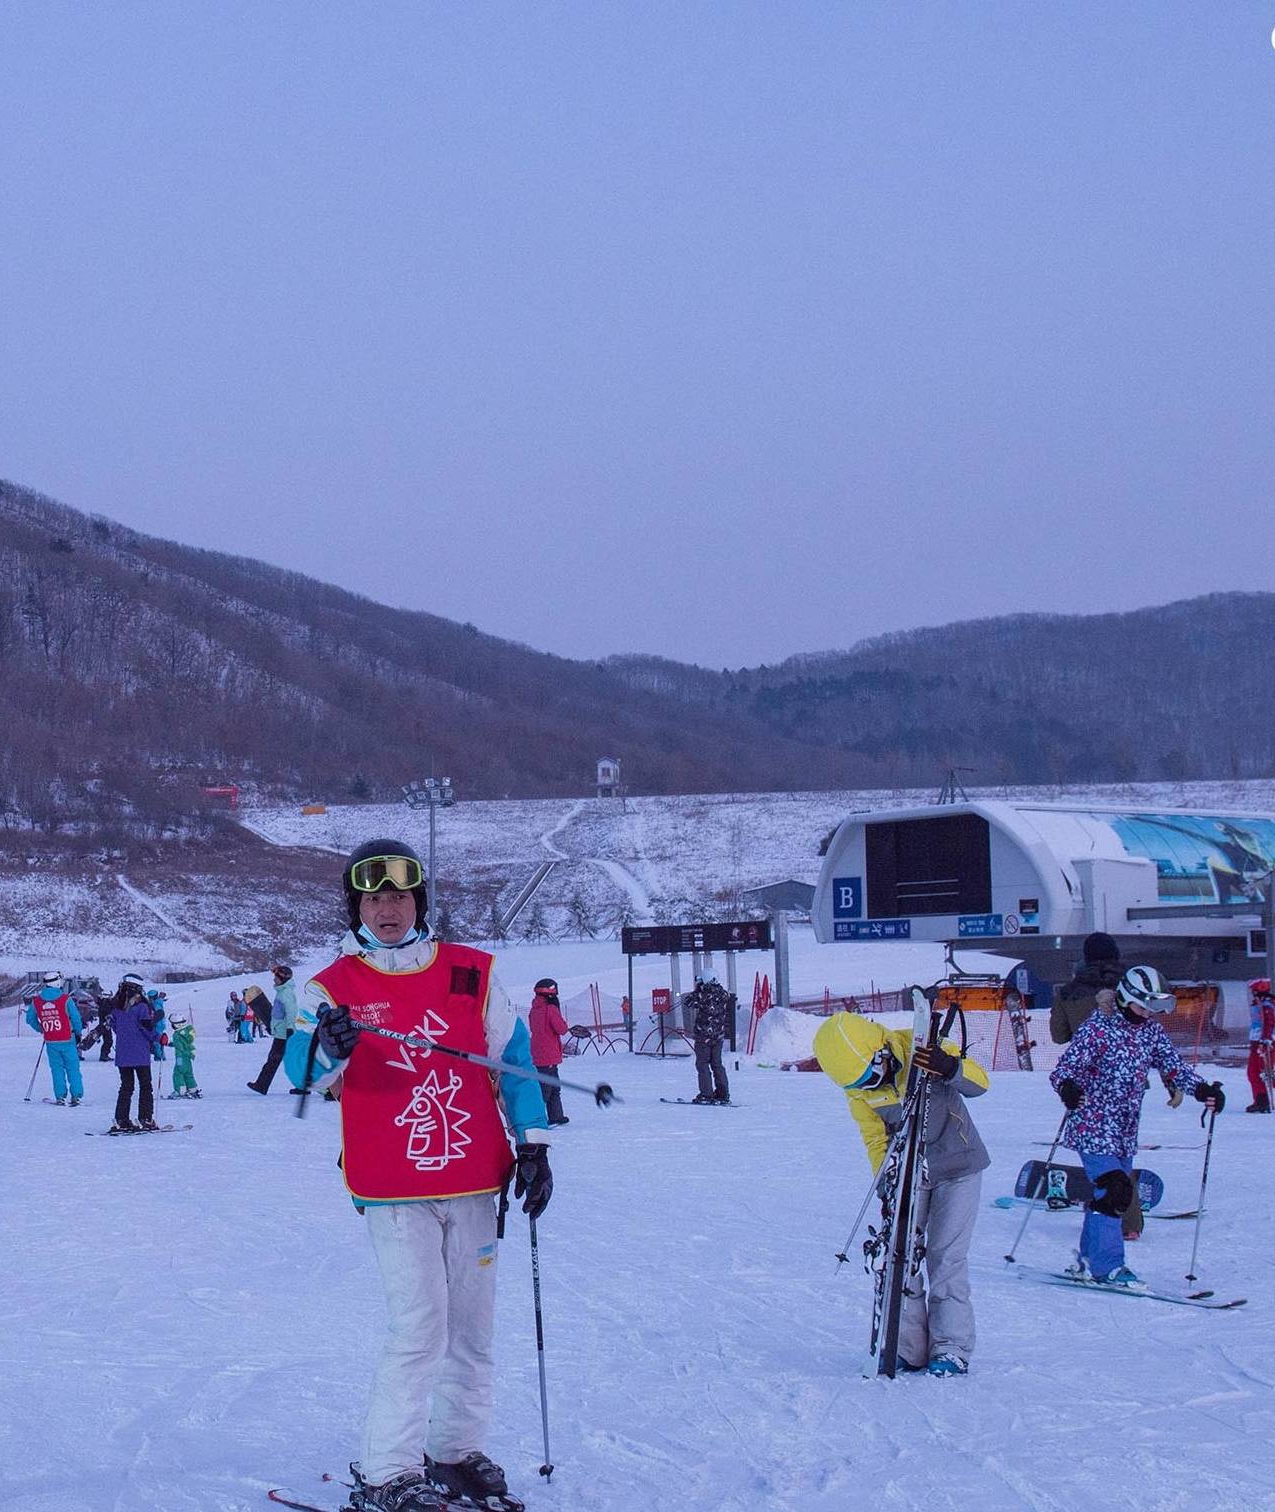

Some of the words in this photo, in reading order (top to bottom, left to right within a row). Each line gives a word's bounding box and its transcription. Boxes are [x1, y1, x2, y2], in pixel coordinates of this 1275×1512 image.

[839, 887, 854, 908] B
[654, 996, 667, 1005] STOP
[43, 1020, 62, 1032] 079
